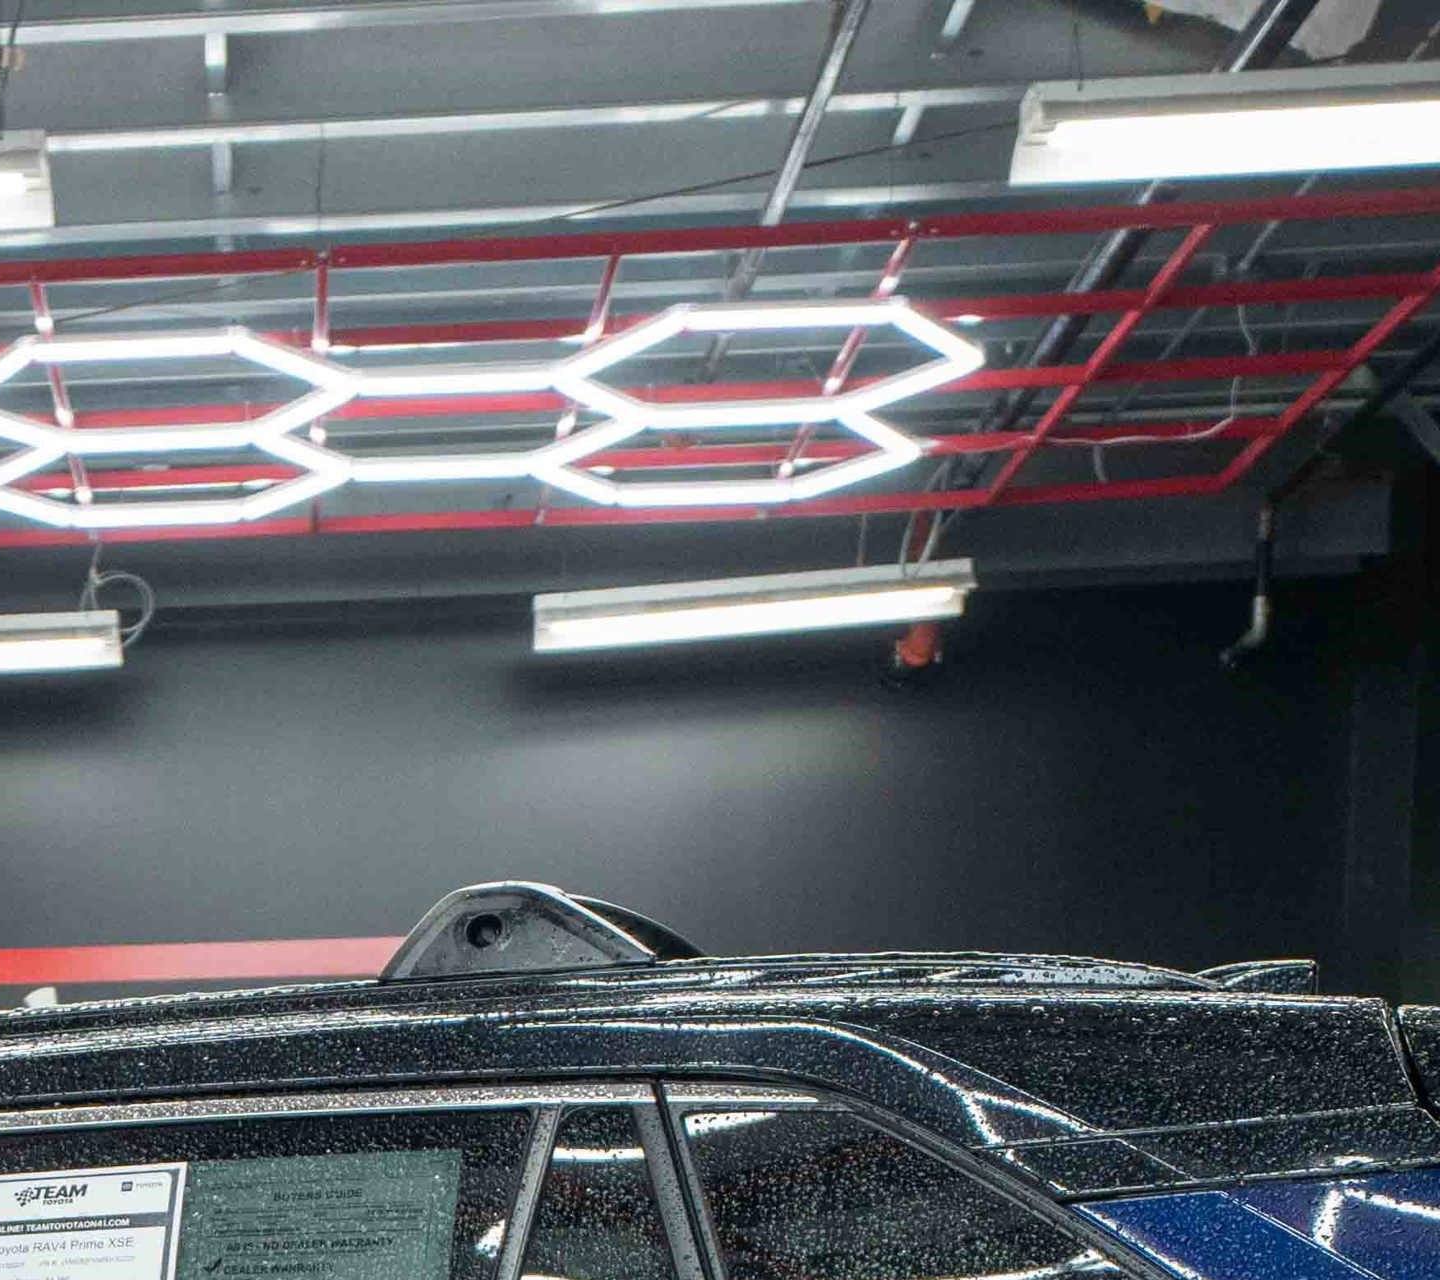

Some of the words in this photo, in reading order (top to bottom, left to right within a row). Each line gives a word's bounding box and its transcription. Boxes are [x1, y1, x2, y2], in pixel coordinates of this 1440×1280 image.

[32, 1184, 88, 1200] TEAM
[33, 1239, 67, 1253] RAV4
[70, 1238, 104, 1251] Prime
[108, 1236, 135, 1248] XSE
